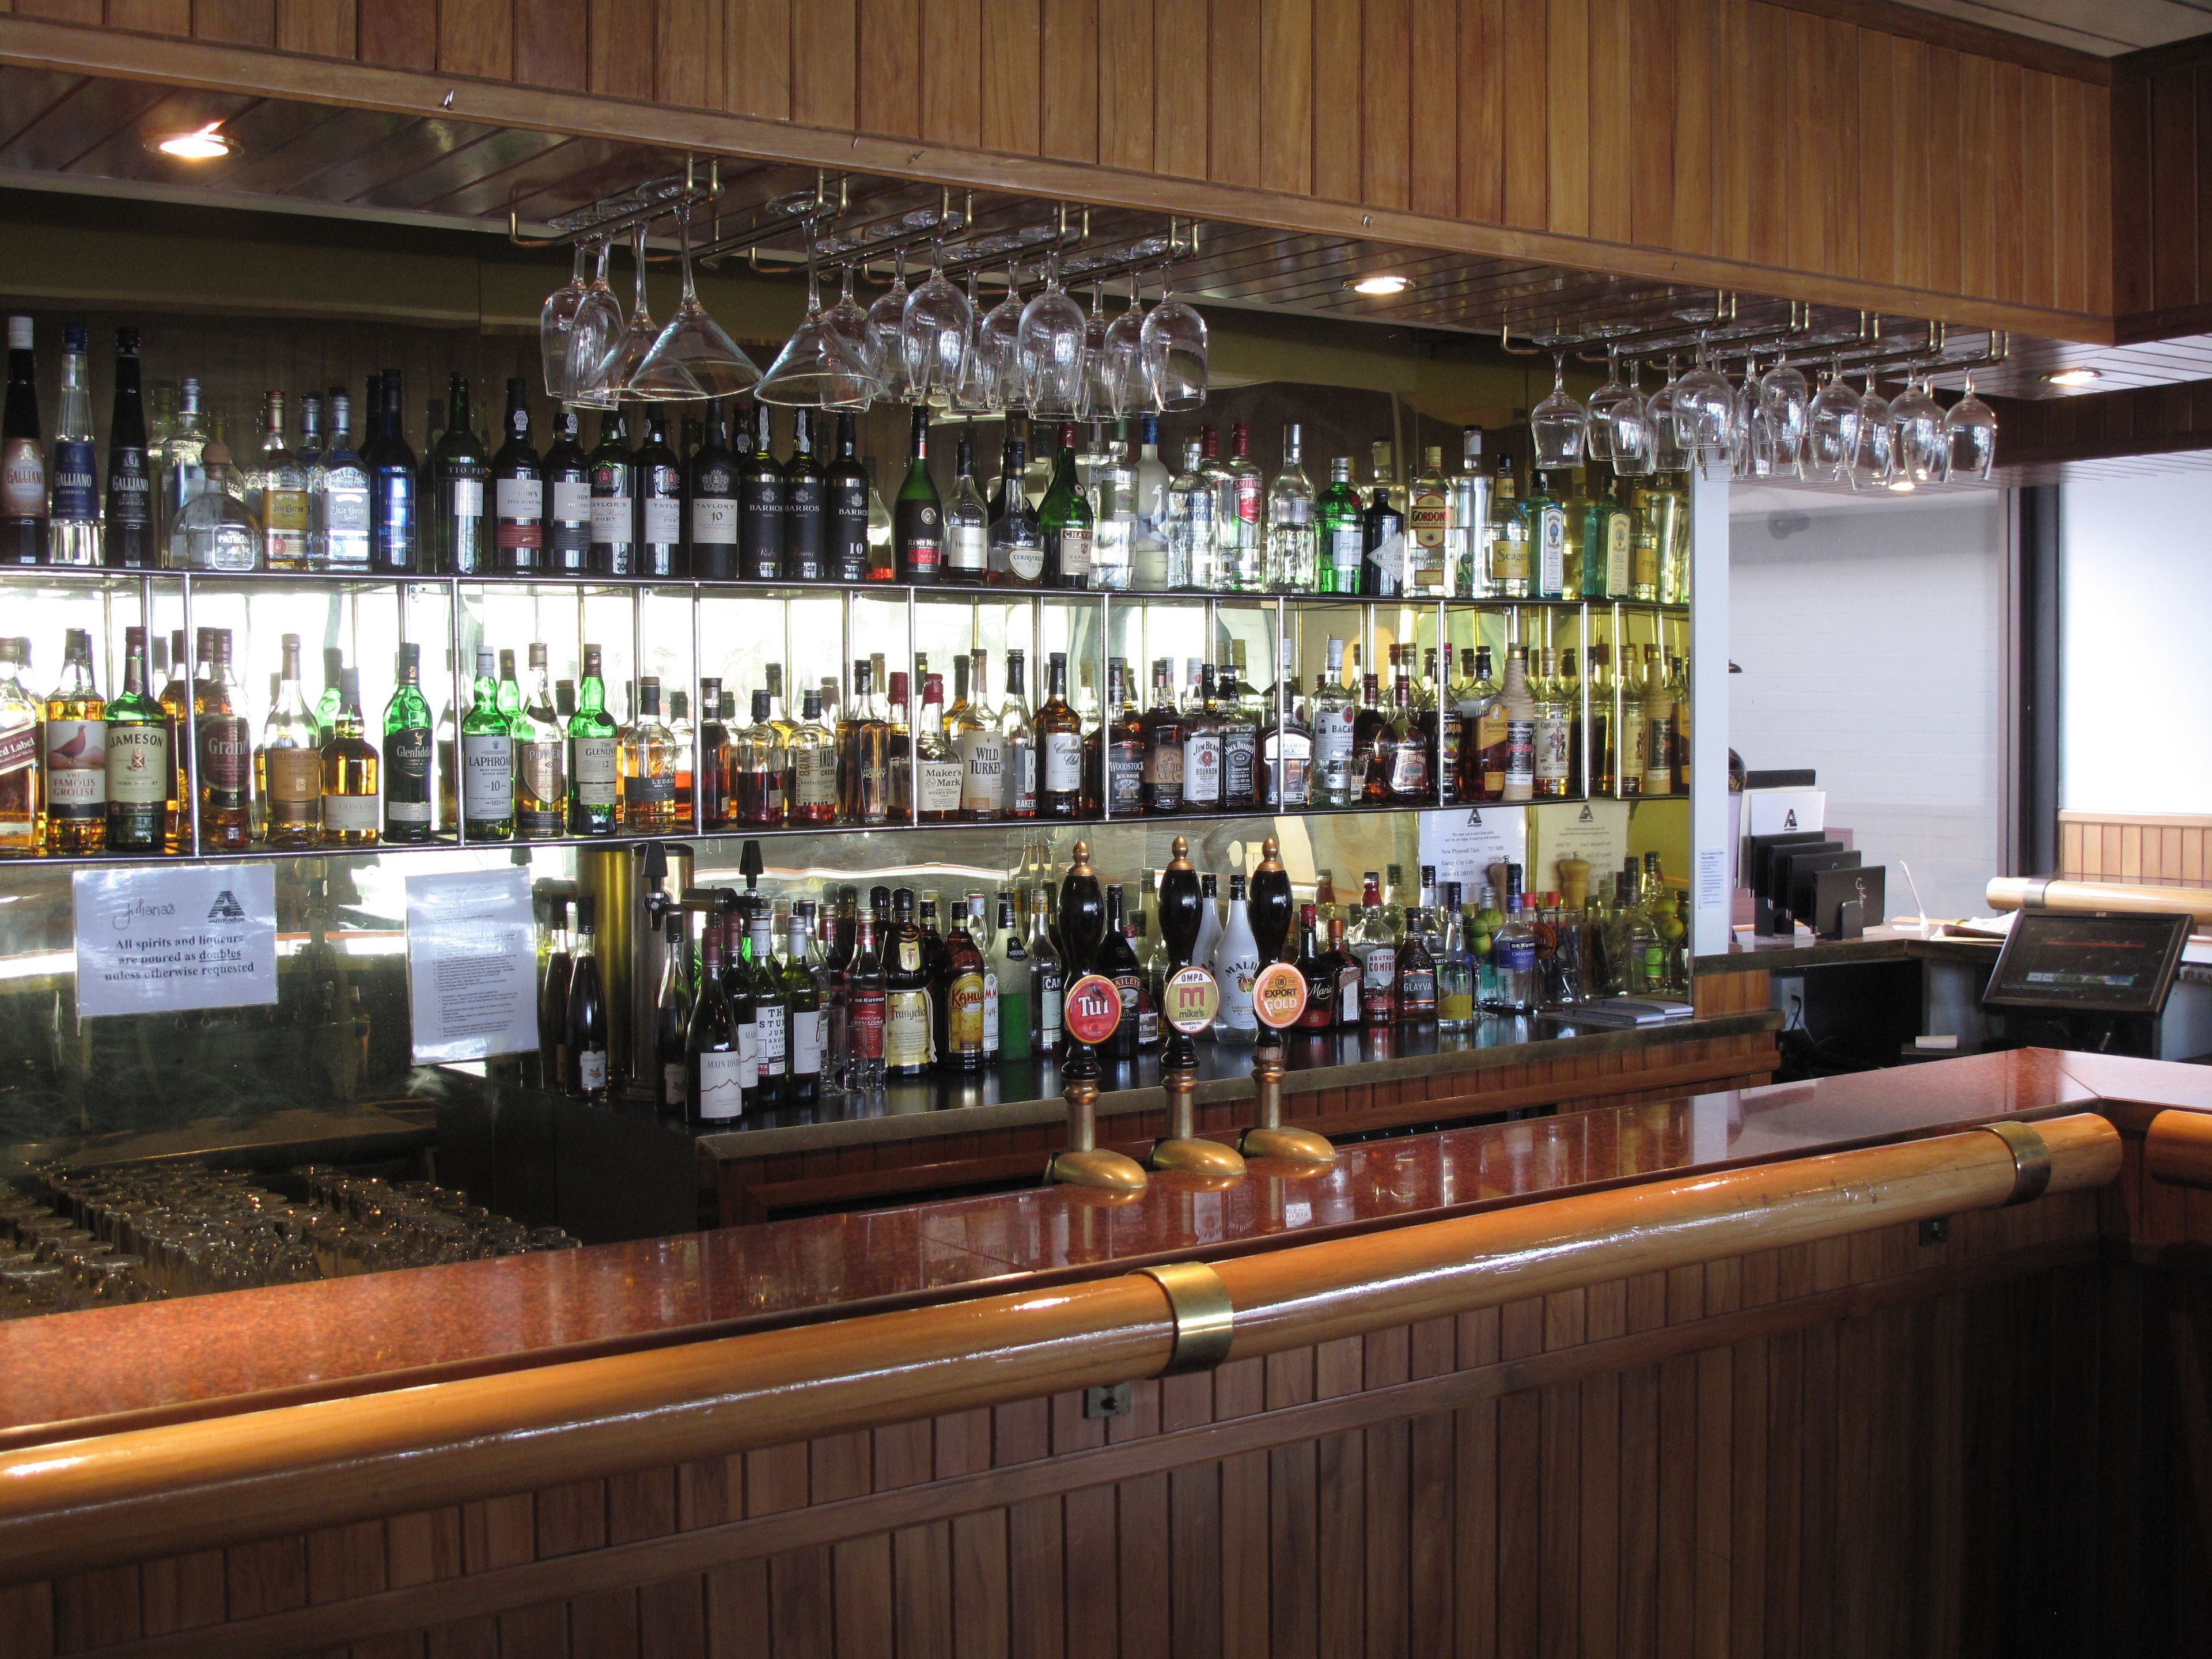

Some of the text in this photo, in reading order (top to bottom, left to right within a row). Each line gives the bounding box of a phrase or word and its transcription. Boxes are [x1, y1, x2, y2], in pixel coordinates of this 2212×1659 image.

[56, 471, 92, 487] GALLIANO
[112, 476, 149, 491] GALLIANO
[711, 512, 722, 523] 10
[849, 543, 863, 554] 10
[956, 540, 983, 550] Hennessy
[1540, 721, 1558, 729] Captain
[111, 733, 164, 748] JAMESON
[0, 746, 10, 757] ed
[10, 737, 35, 753] Label
[1194, 742, 1205, 756] JIM
[1225, 744, 1237, 755] JACK
[820, 749, 834, 768] KNOB
[976, 747, 998, 761] WILD
[969, 760, 1001, 775] TURKEY
[1025, 749, 1036, 793] B
[1109, 761, 1145, 772] WOODSTOCK
[54, 779, 96, 787] FAMOUS
[491, 781, 500, 791] 10
[937, 778, 961, 786] Mark
[54, 787, 96, 796] GROUSE
[116, 934, 244, 950] All spirits and liqueurs
[119, 956, 138, 964] are
[141, 952, 181, 965] poured
[199, 949, 241, 962] doubles
[105, 962, 255, 980] unless otherwise requested
[1115, 977, 1141, 987] AILEYS
[1181, 974, 1203, 982] OMPA
[1309, 983, 1332, 997] Maria
[1404, 982, 1432, 991] GLAYVA
[1264, 988, 1297, 997] EXPORT
[1078, 996, 1109, 1017] Tui
[1267, 998, 1297, 1010] GOLD
[1179, 1009, 1205, 1018] mike's
[707, 1060, 725, 1069] MAIN
